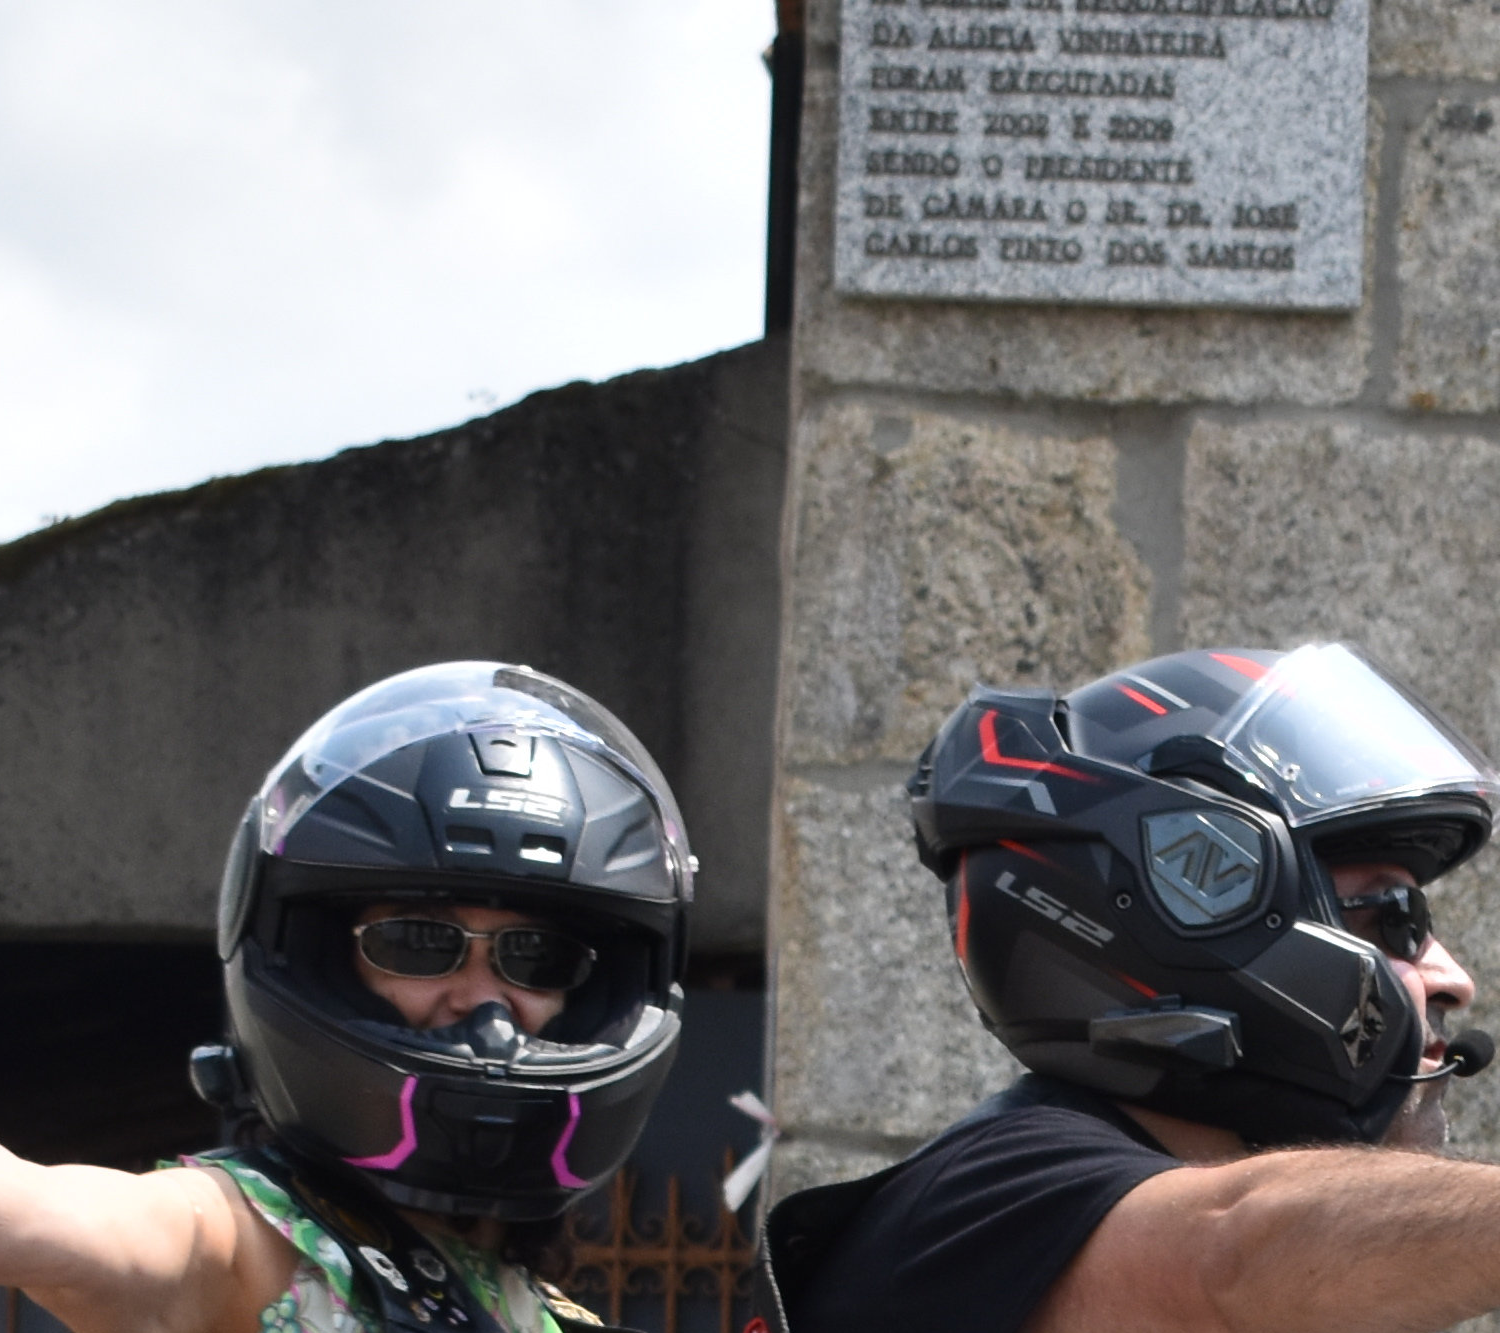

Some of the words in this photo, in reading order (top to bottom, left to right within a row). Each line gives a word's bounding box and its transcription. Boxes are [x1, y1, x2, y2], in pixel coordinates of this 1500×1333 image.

[870, 21, 912, 48] DA
[928, 26, 1036, 51] ALDEIA
[1058, 29, 1227, 58] VINHATEIRA
[869, 65, 966, 92] FORAM
[989, 68, 1177, 99] EXECUTADAS
[868, 107, 959, 134] ENTRE
[984, 111, 1049, 138] 2002
[865, 151, 960, 178] SENDO
[981, 154, 1003, 179] O
[1025, 155, 1194, 185] PRESIDENTE
[864, 194, 902, 219] DE
[1066, 200, 1088, 224] O
[864, 232, 979, 260] CARLOS
[1000, 237, 1083, 264] PINTO
[1107, 239, 1166, 267] DOS
[1187, 242, 1297, 272] SANTOS
[448, 787, 564, 822] LS2
[995, 870, 1115, 949] LS2
